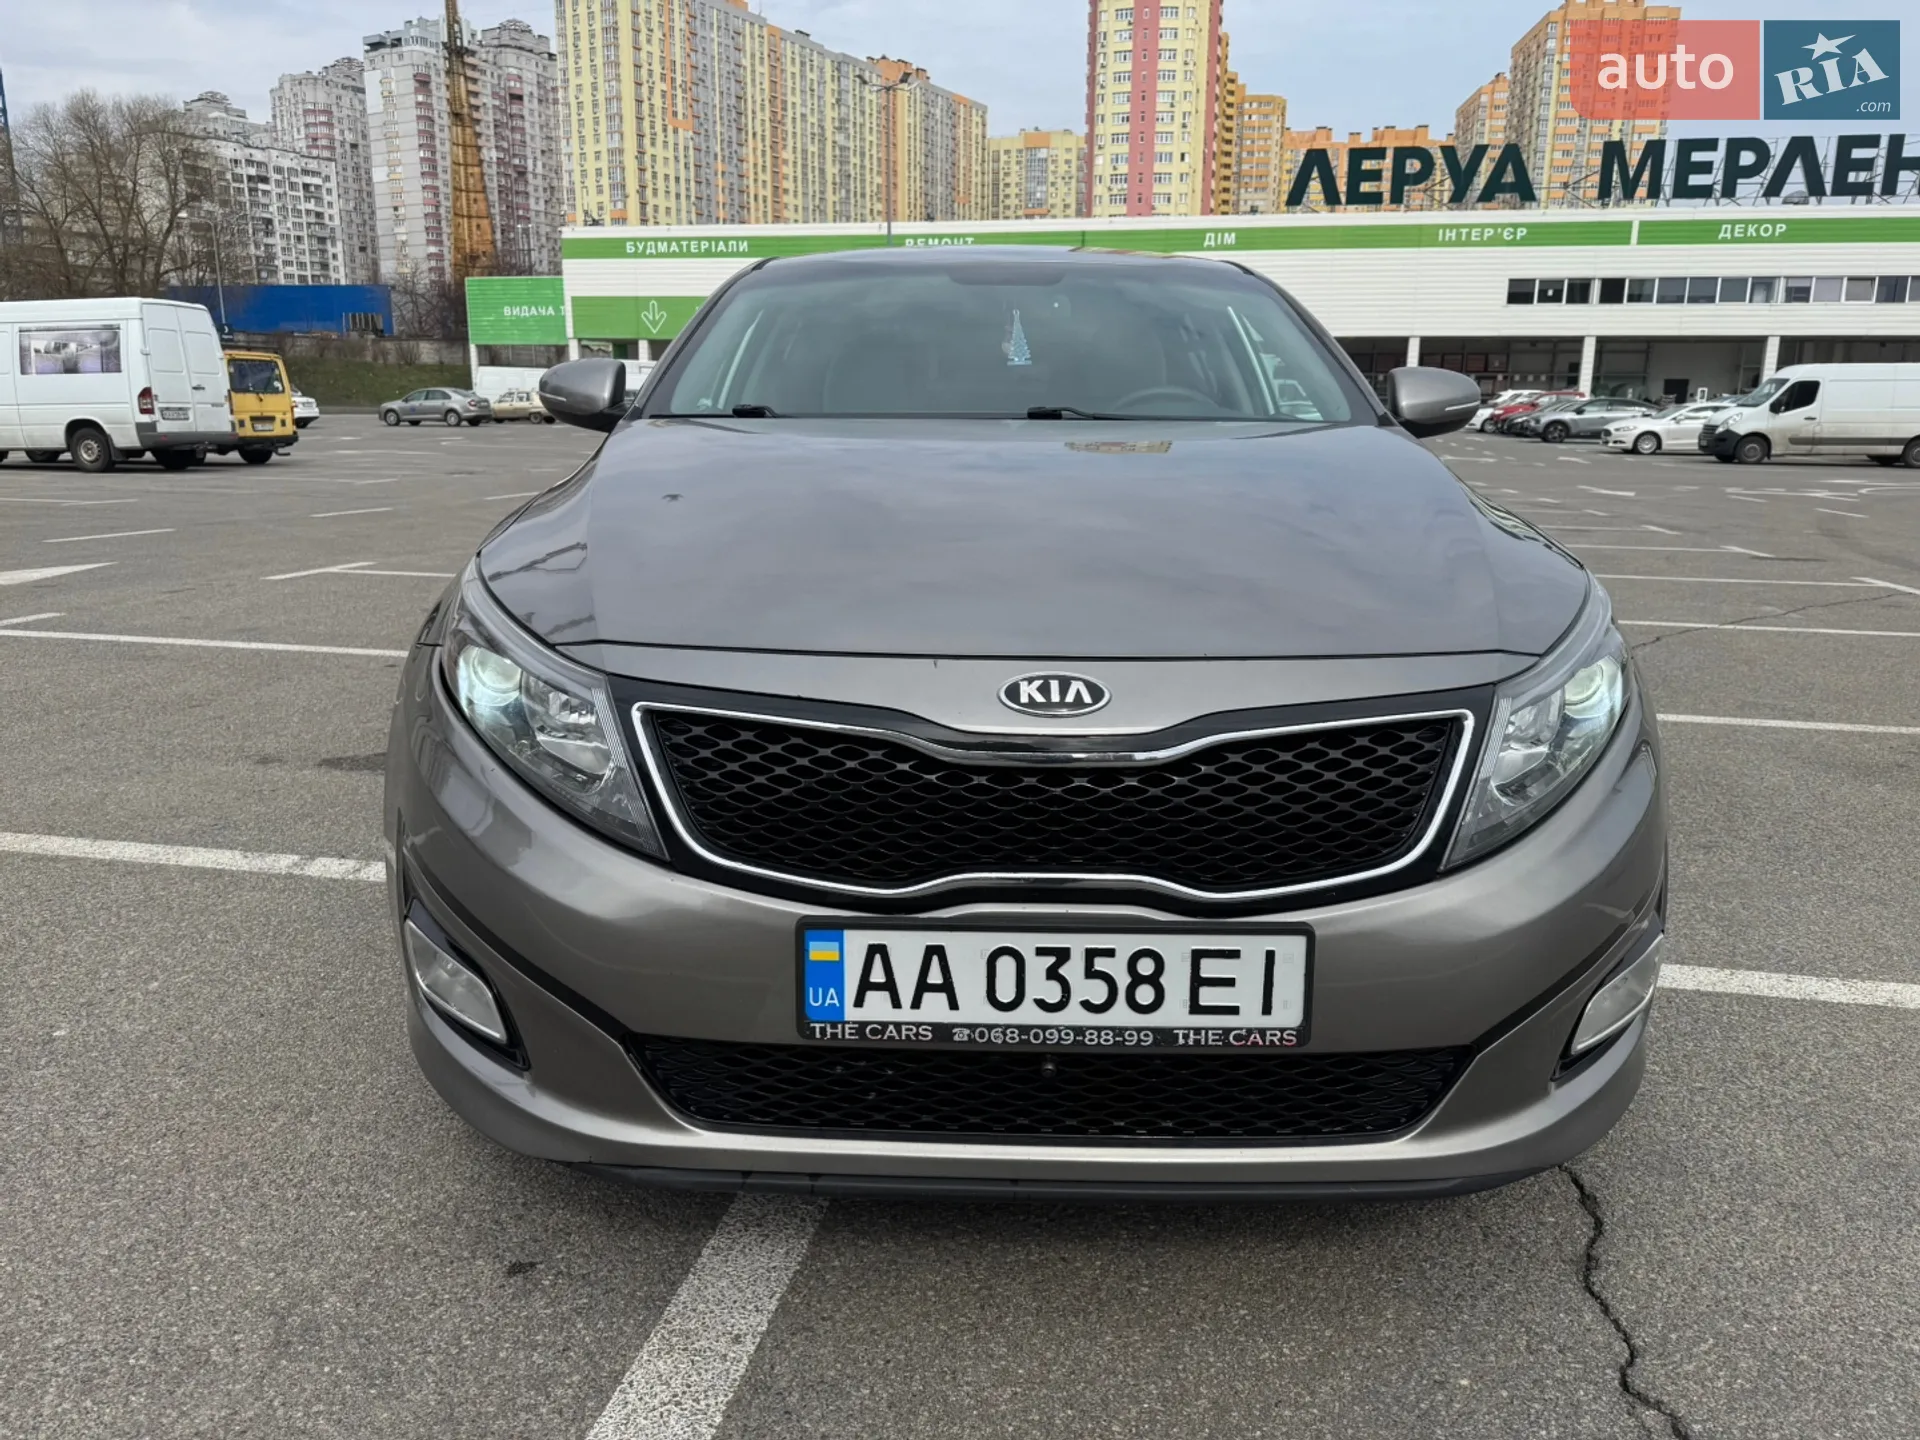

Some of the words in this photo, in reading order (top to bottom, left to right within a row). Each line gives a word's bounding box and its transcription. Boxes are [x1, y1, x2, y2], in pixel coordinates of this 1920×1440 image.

[1285, 142, 1537, 206] ЛЕРУА
[1203, 232, 1237, 248] ДІМ
[1438, 227, 1527, 242] ІНТЕР'ЄР
[1718, 223, 1787, 240] ДЕКОР
[625, 240, 749, 255] БУДМАТЕРІАЛИ
[503, 305, 556, 318] ВИДАЧА
[1018, 679, 1093, 704] KIA
[852, 942, 960, 1011] AA
[986, 945, 1166, 1015] 0358
[1188, 948, 1276, 1016] EI
[809, 987, 840, 1007] UA
[810, 1023, 859, 1040] THE
[865, 1024, 933, 1041] CARS
[1173, 1029, 1223, 1046] THE
[1229, 1029, 1298, 1047] CARS
